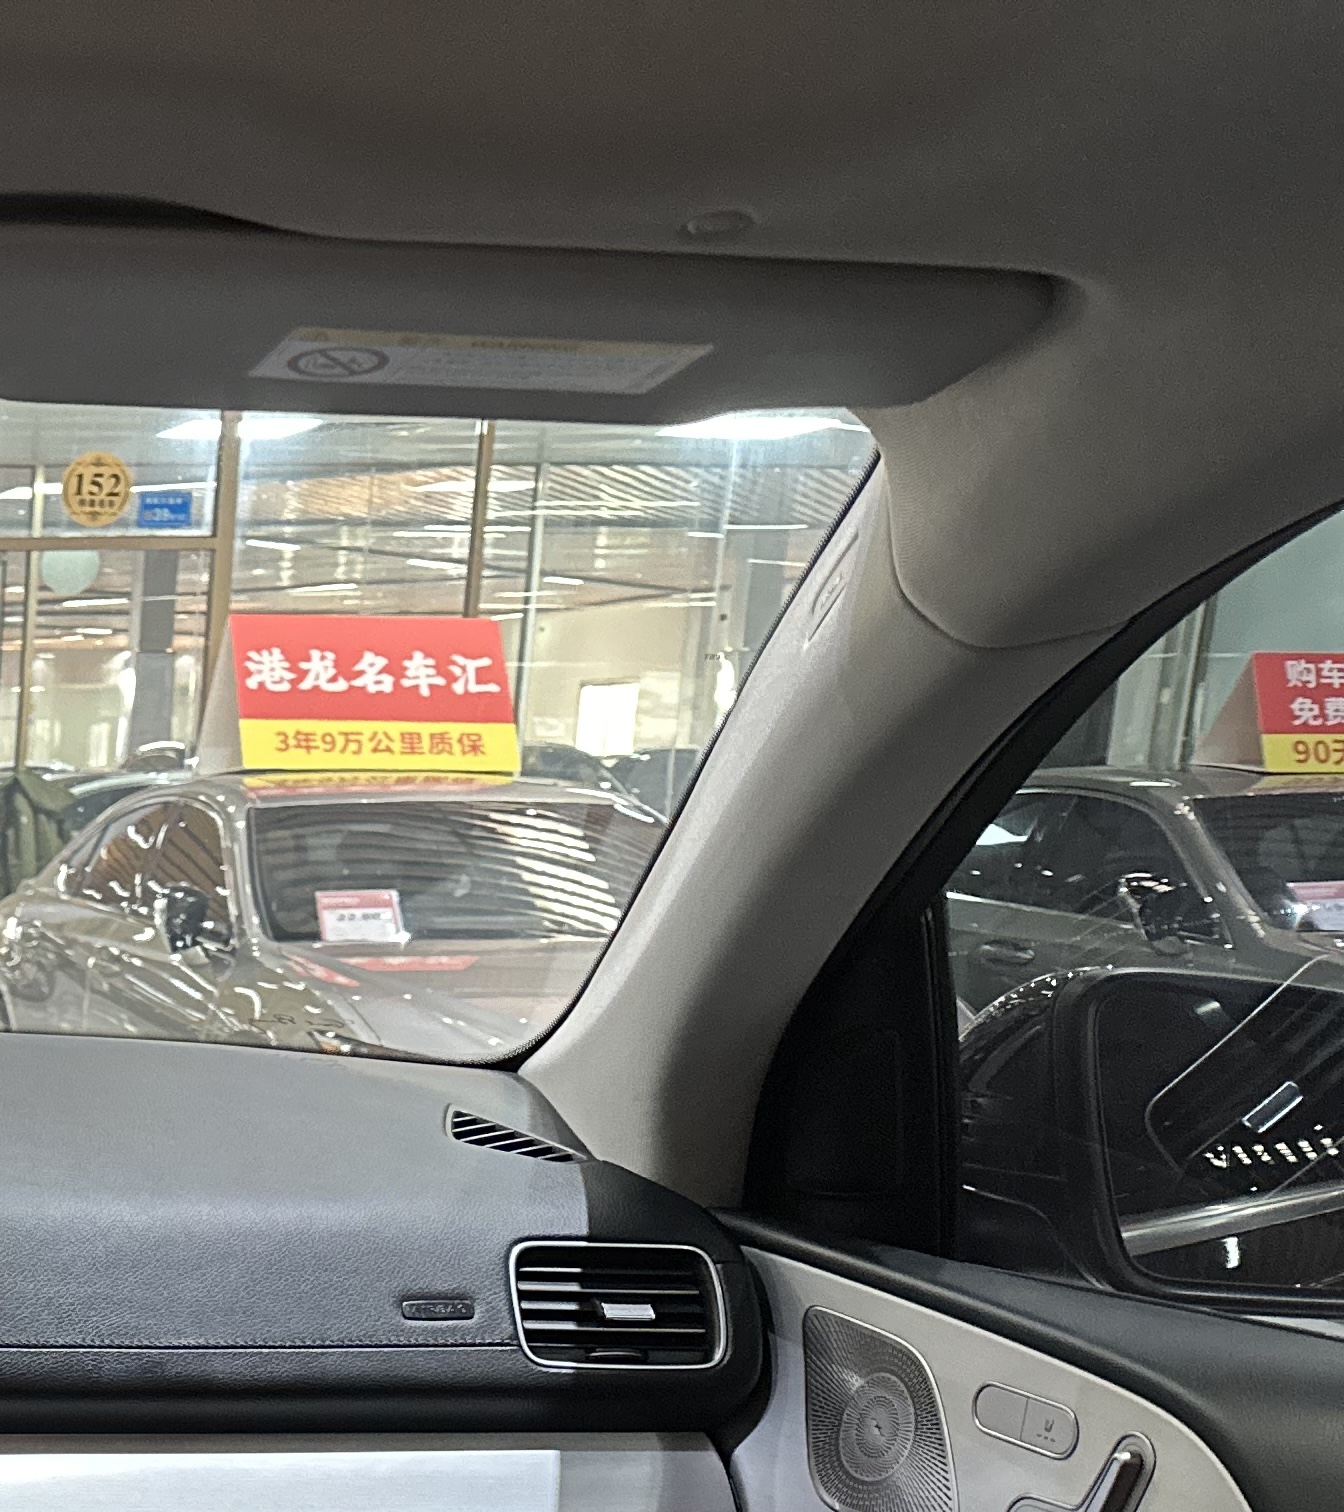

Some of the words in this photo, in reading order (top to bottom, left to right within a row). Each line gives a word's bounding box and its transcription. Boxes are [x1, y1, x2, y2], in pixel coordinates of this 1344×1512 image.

[74, 473, 121, 497] 152
[244, 647, 501, 697] 港龙名车汇
[274, 730, 487, 756] 3年9万公里质保
